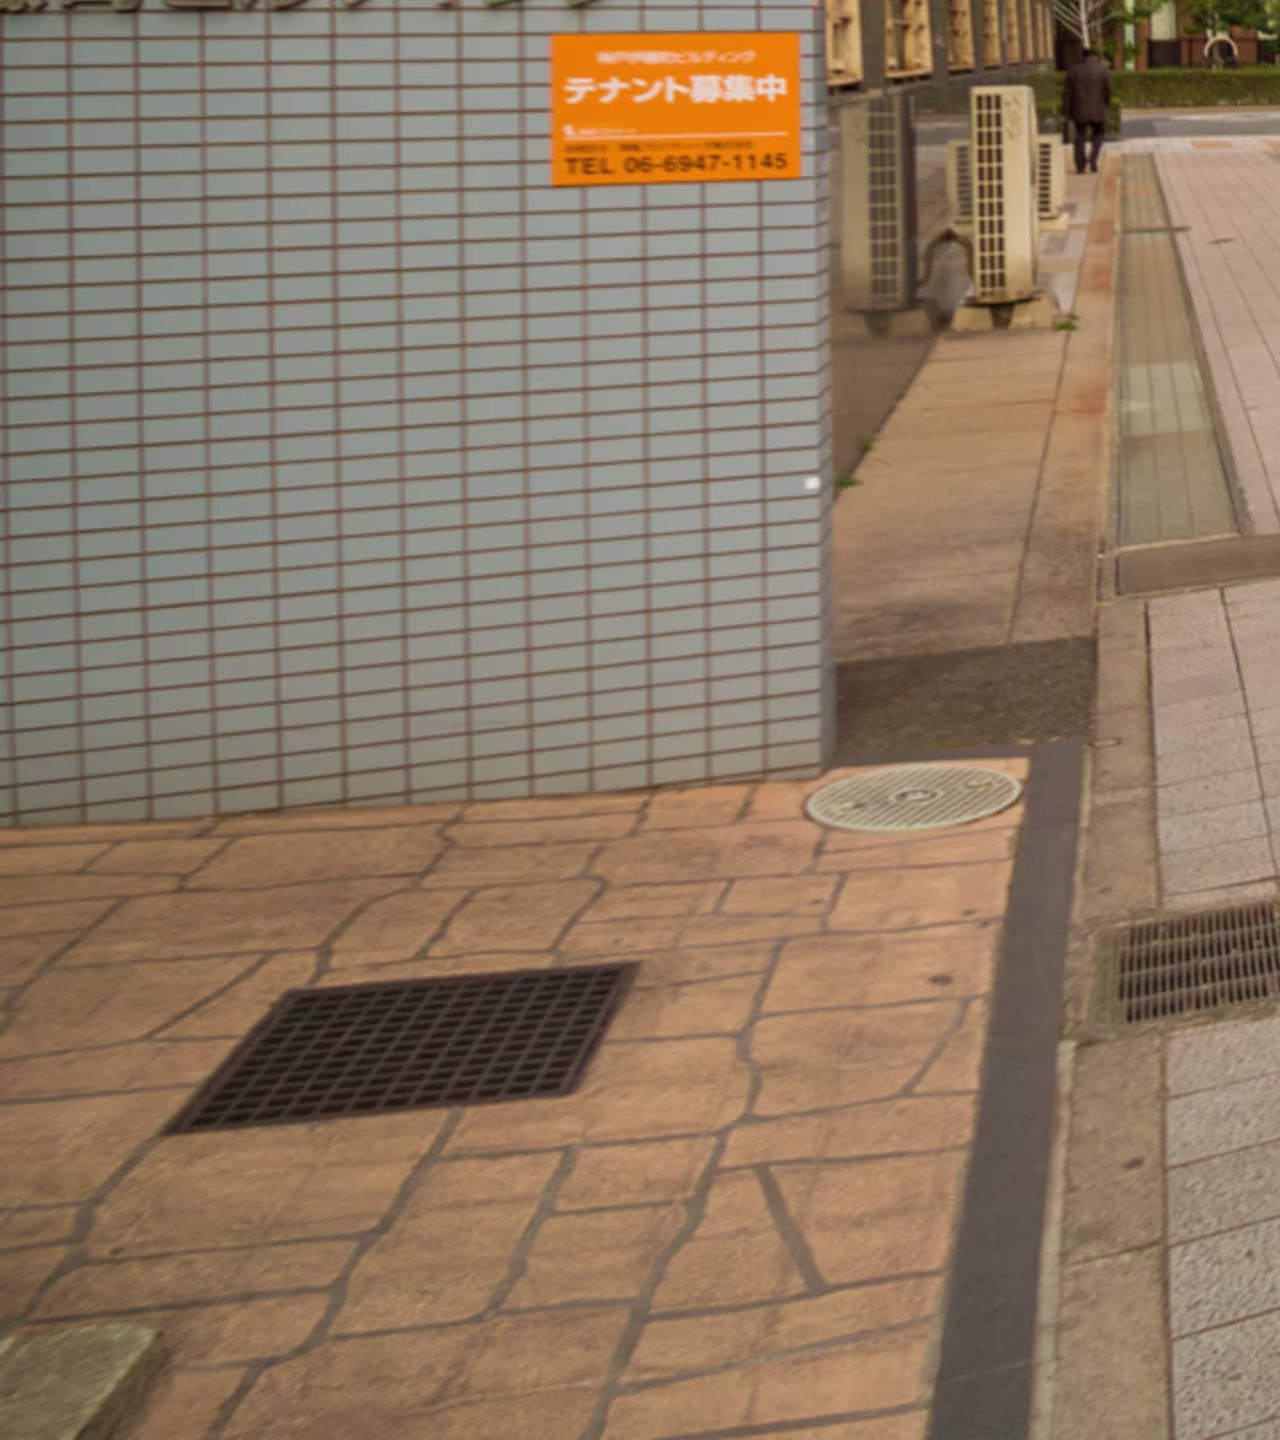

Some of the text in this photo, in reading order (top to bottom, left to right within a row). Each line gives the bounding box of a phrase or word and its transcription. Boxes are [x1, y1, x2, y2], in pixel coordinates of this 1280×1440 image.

[564, 74, 788, 104] テナント募集中
[564, 152, 789, 175] TEL 06-6947-1145
